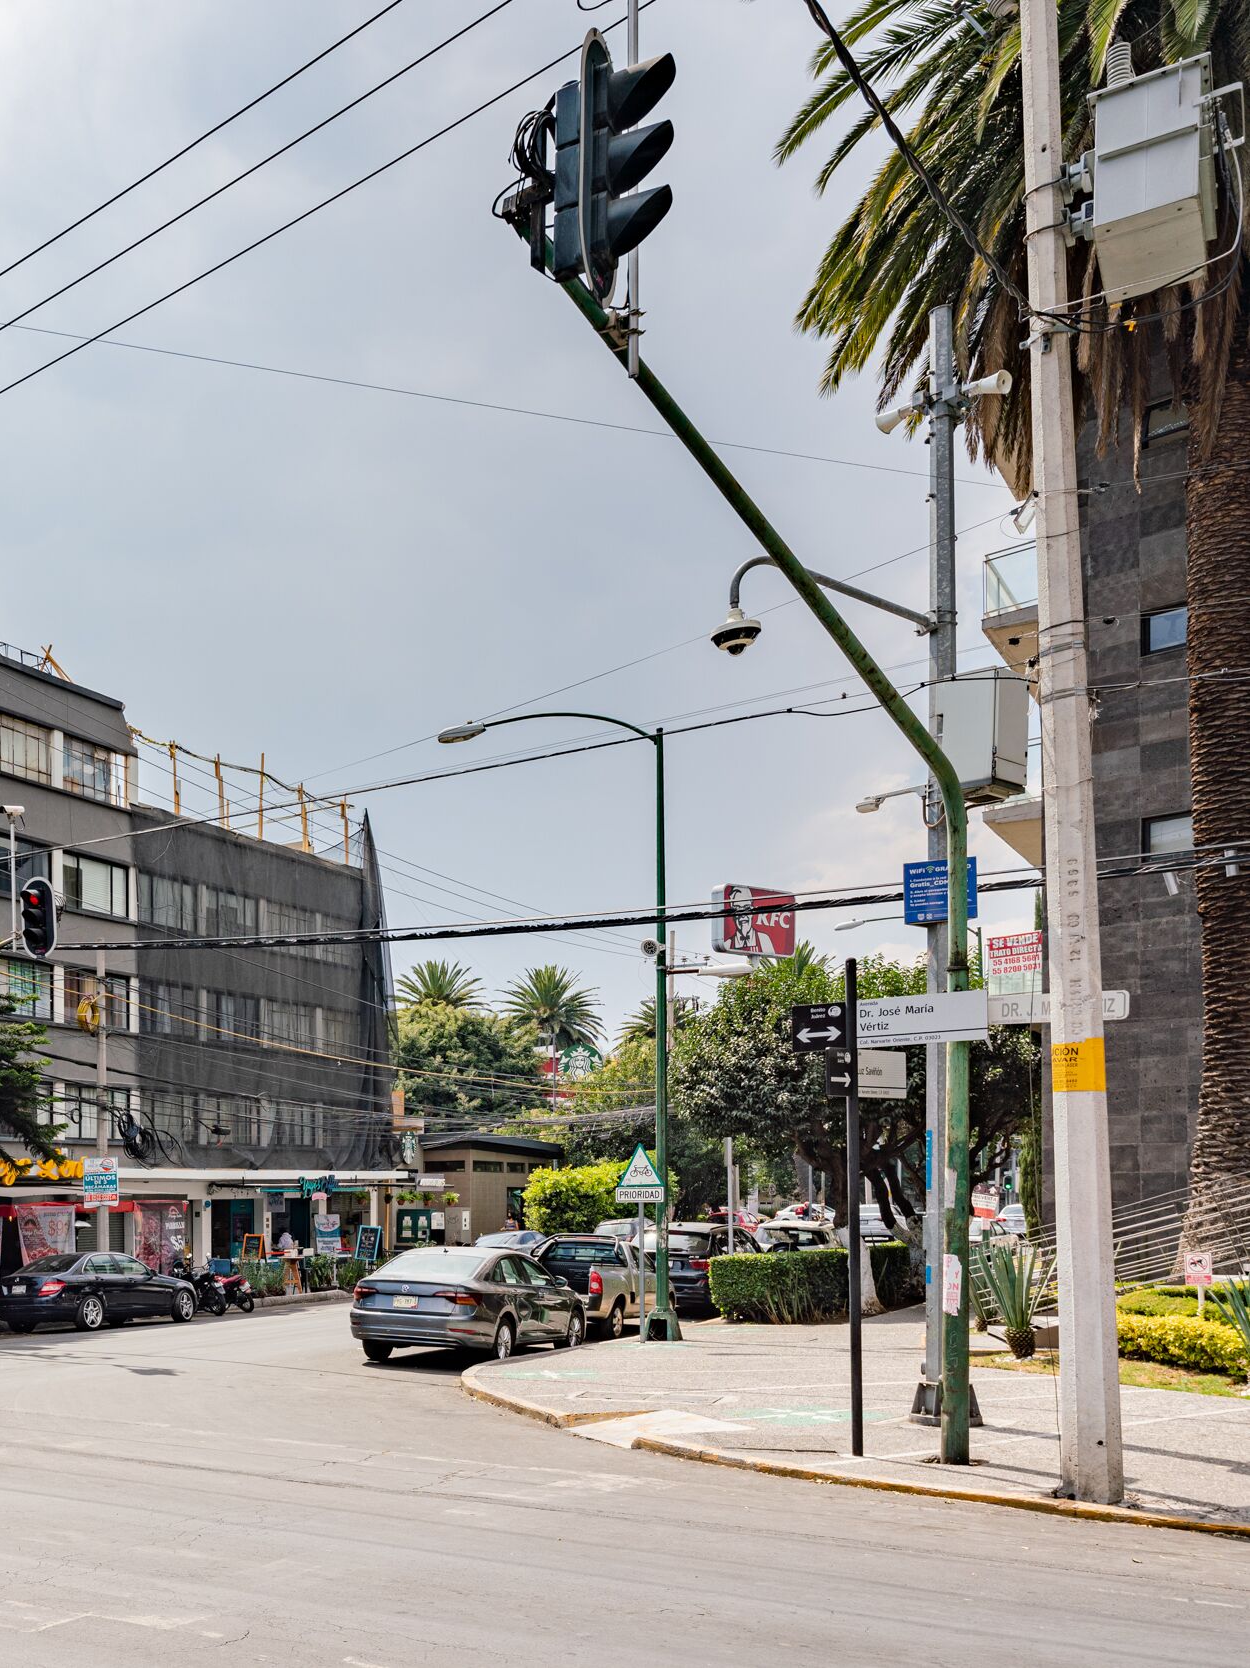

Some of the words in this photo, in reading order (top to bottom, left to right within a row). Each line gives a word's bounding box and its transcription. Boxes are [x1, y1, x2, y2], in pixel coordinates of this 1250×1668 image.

[755, 910, 791, 928] KFC
[992, 938, 1005, 948] SE
[1006, 933, 1038, 946] VENDE
[990, 949, 1011, 957] TRATO
[859, 1009, 874, 1018] Dr.
[878, 1006, 901, 1017] José
[905, 1003, 934, 1015] María
[1001, 1003, 1022, 1017] DR.
[860, 1021, 889, 1031] Vértiz
[620, 1191, 660, 1199] PRIORIDAD
